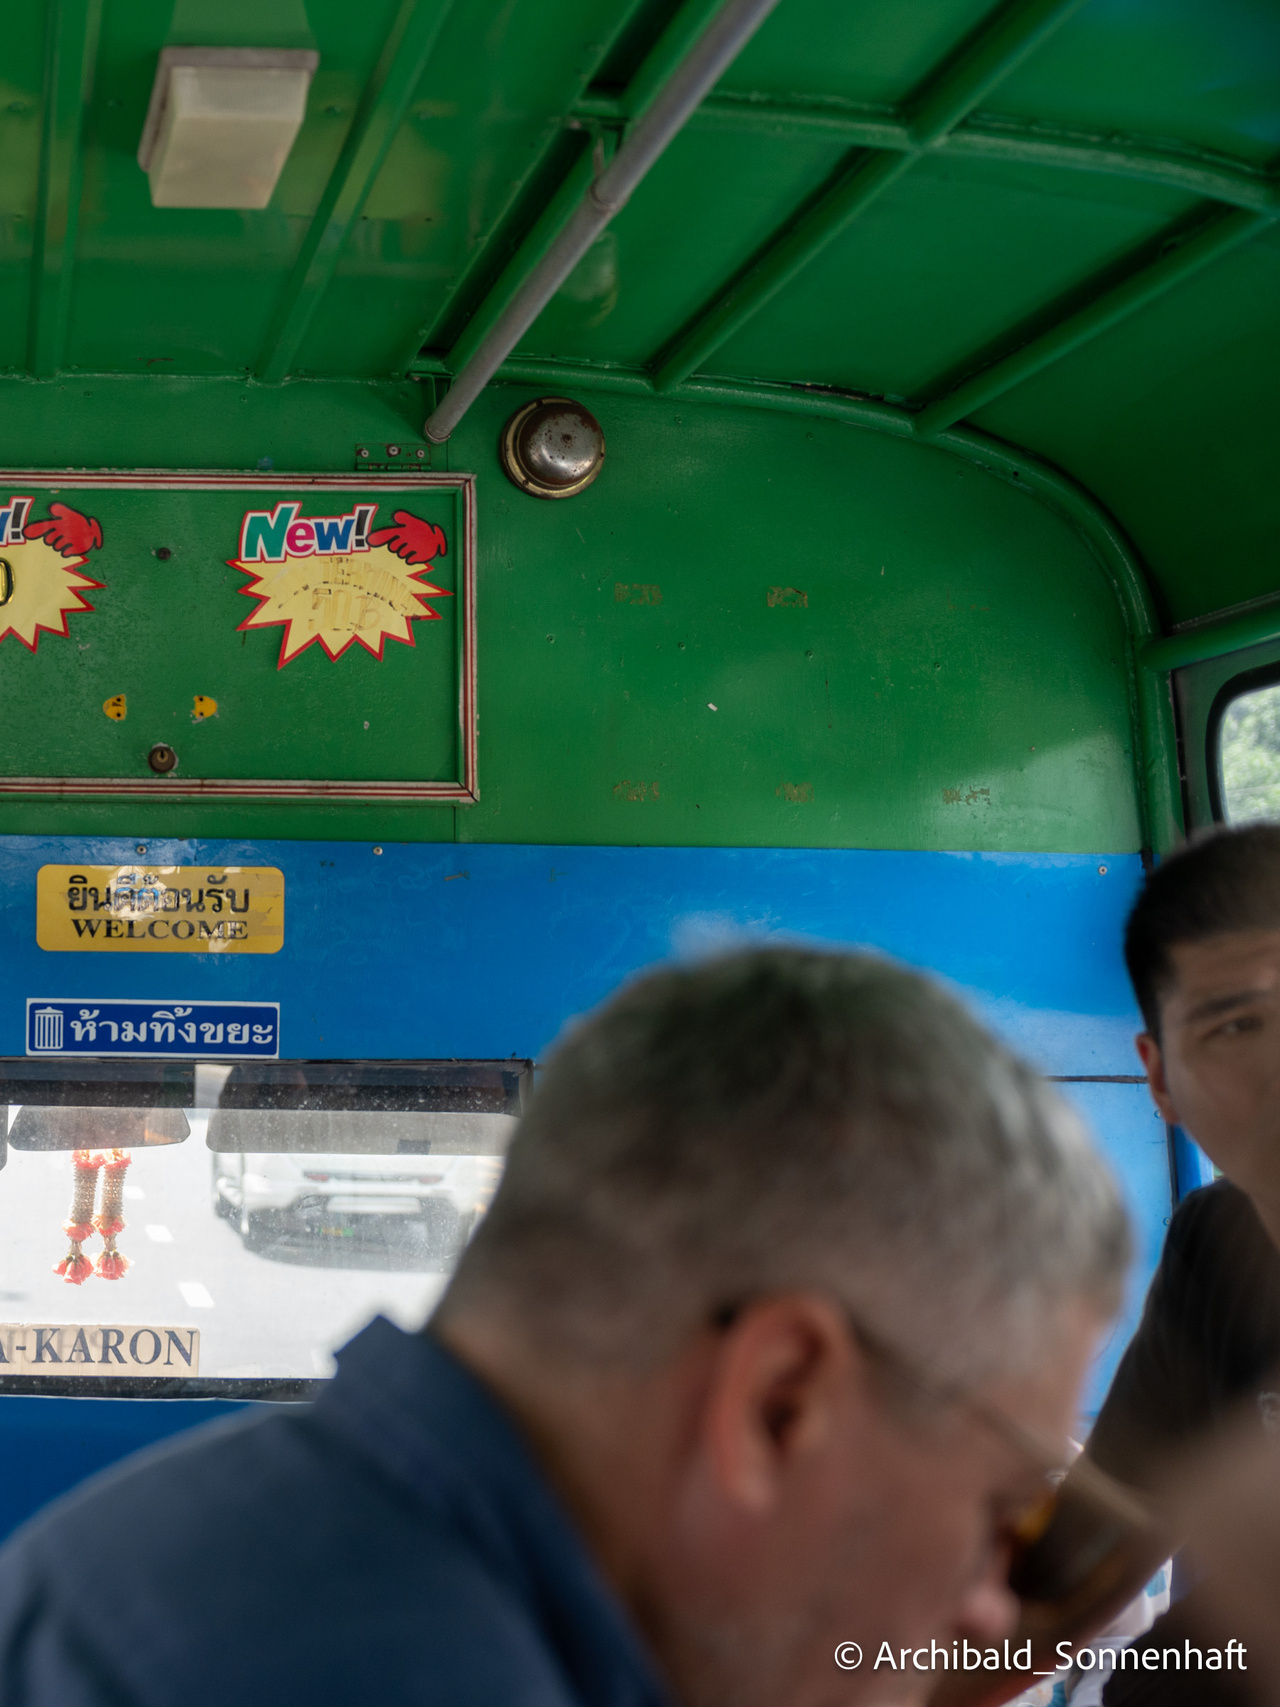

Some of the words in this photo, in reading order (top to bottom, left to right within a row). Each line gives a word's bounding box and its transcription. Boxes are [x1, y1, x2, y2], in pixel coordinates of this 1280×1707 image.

[243, 505, 372, 559] New!
[70, 917, 250, 940] WELCOME
[70, 1005, 274, 1045] ห้ามทิ้งขยะ
